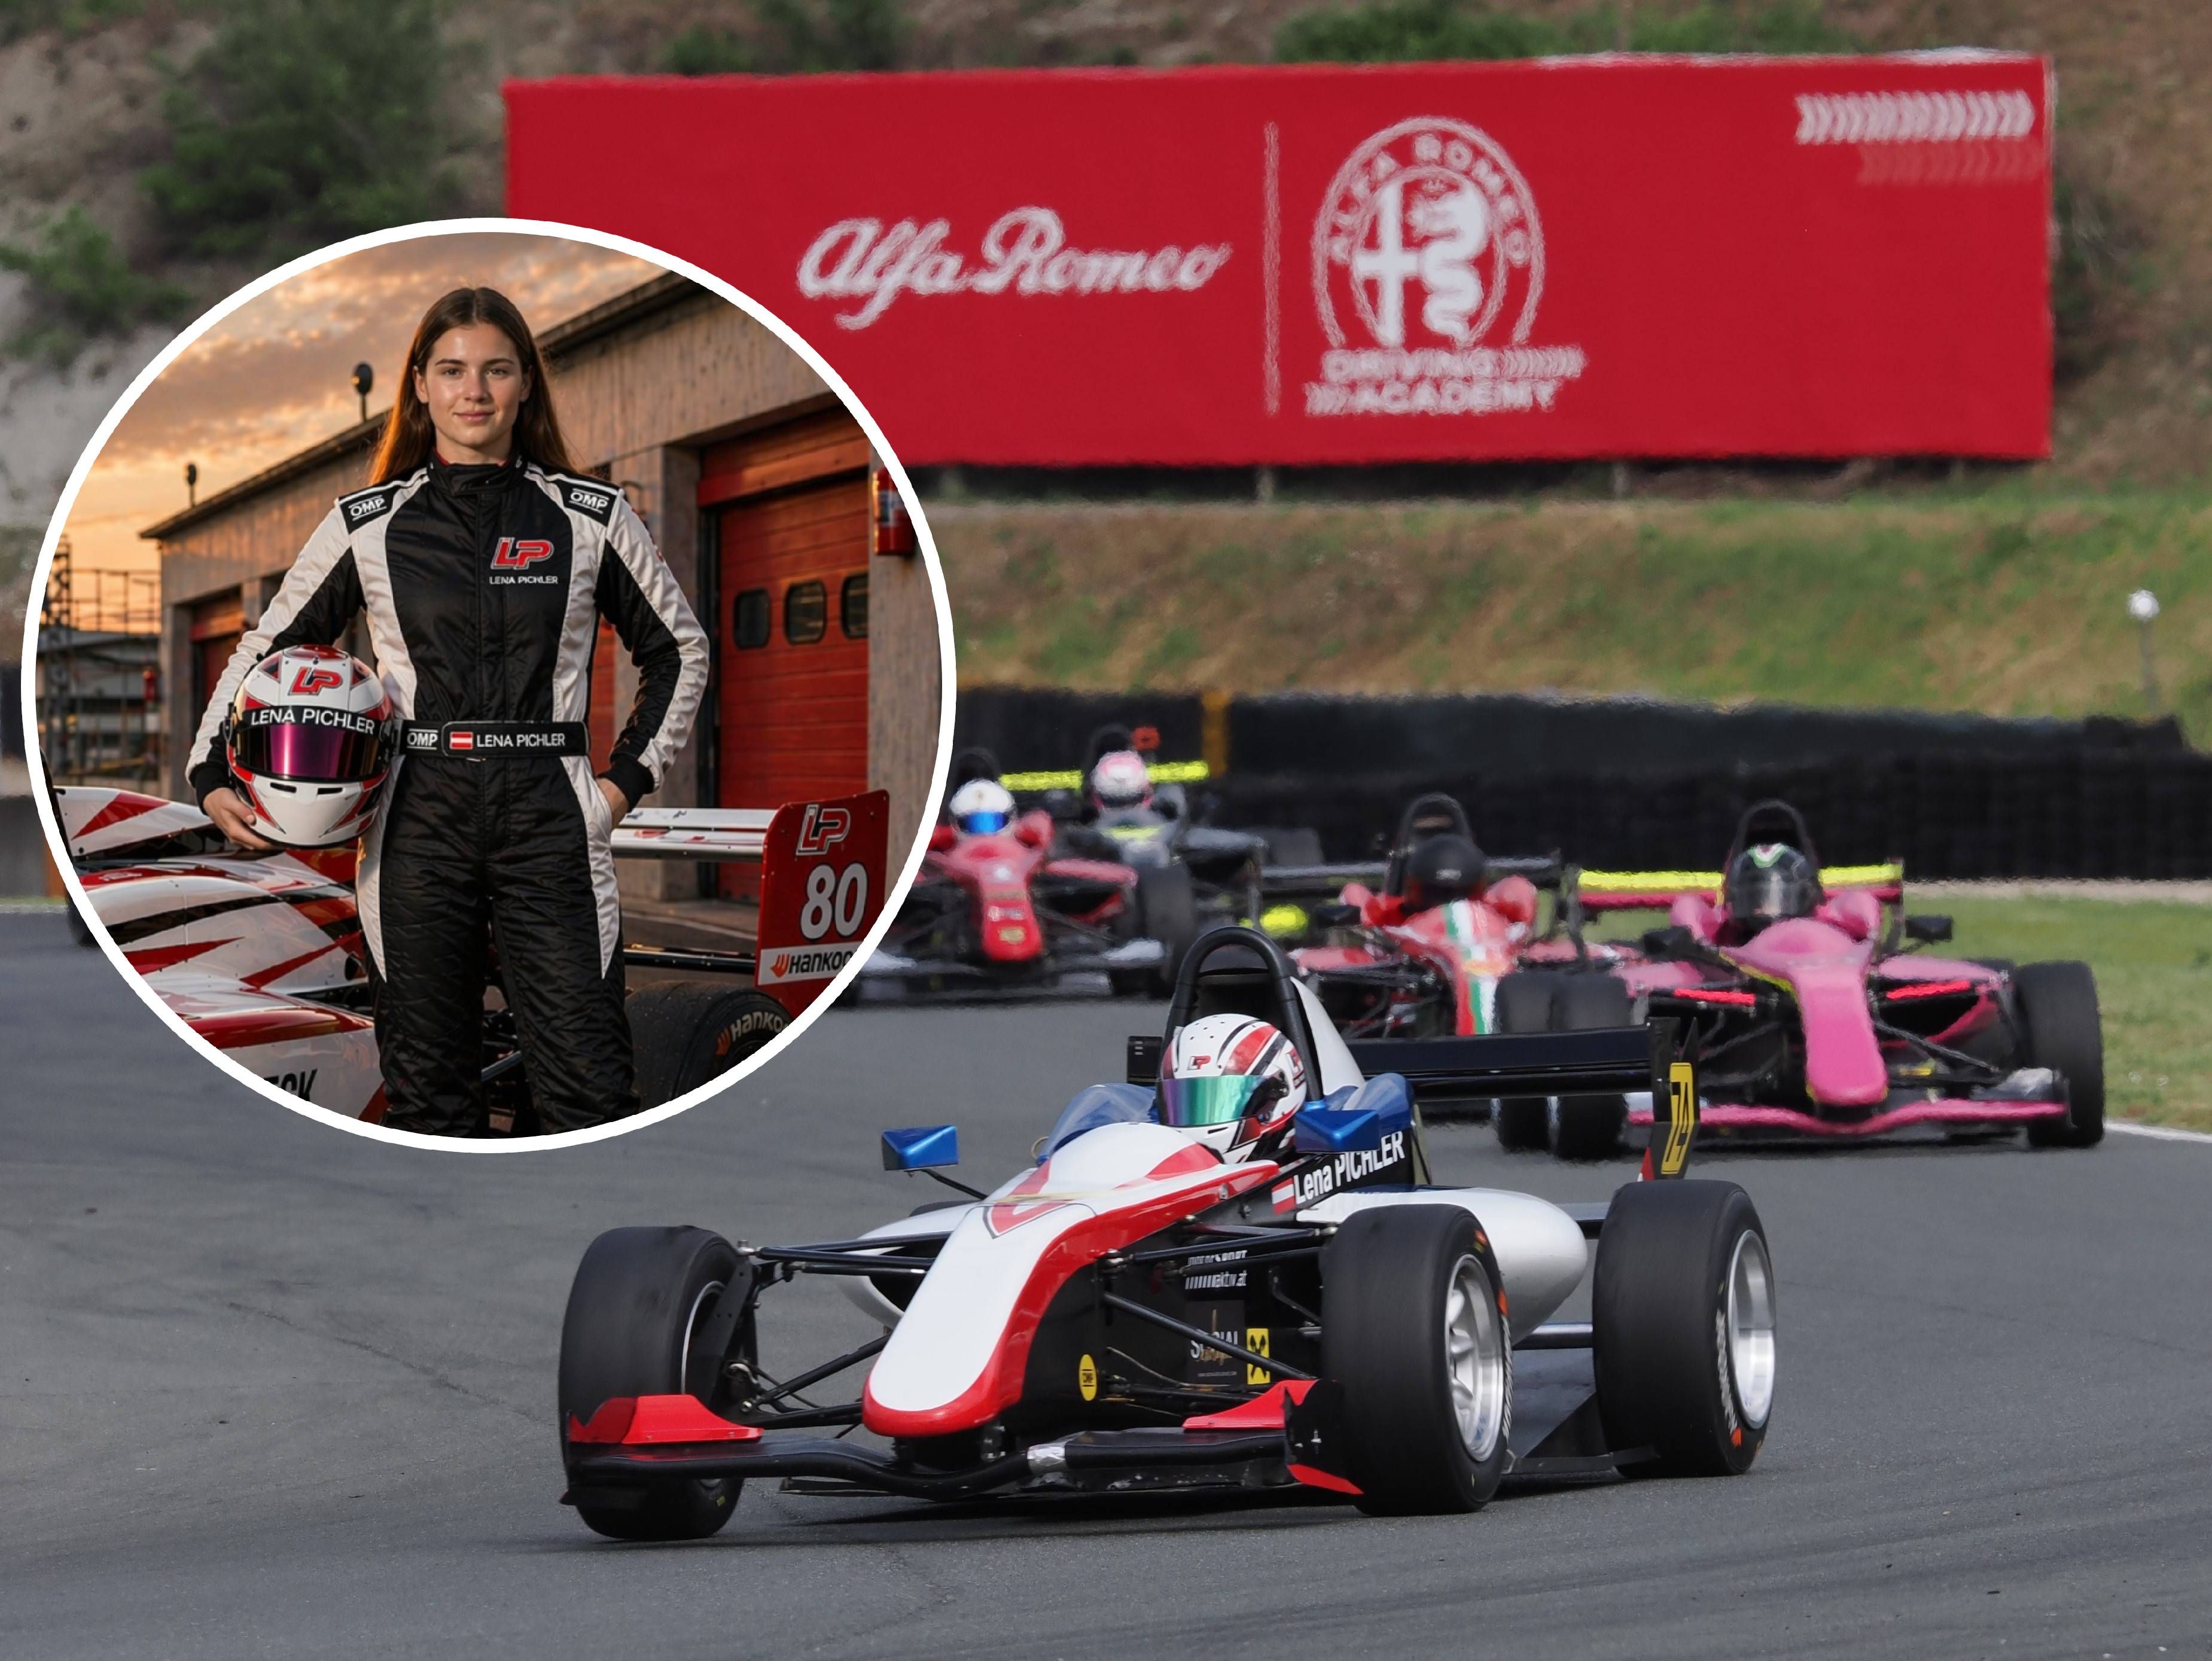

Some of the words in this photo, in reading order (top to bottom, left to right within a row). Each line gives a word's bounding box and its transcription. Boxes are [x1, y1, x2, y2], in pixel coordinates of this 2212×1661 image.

[797, 215, 964, 331] Alfa
[970, 205, 1233, 297] Romeo
[351, 498, 385, 516] OMP
[571, 492, 607, 510] OMP
[490, 537, 554, 569] LP
[489, 576, 515, 584] LENA
[517, 576, 558, 584] PICHLER
[288, 666, 344, 696] LP
[251, 708, 295, 726] LENA
[301, 708, 374, 735] PICHLER
[407, 733, 437, 746] OMP
[477, 735, 513, 747] LENA
[517, 733, 565, 747] PICHLER
[796, 804, 851, 856] LP
[801, 862, 867, 939] 80
[1293, 1165, 1333, 1204] Lena
[1334, 1130, 1405, 1187] PICHLER
